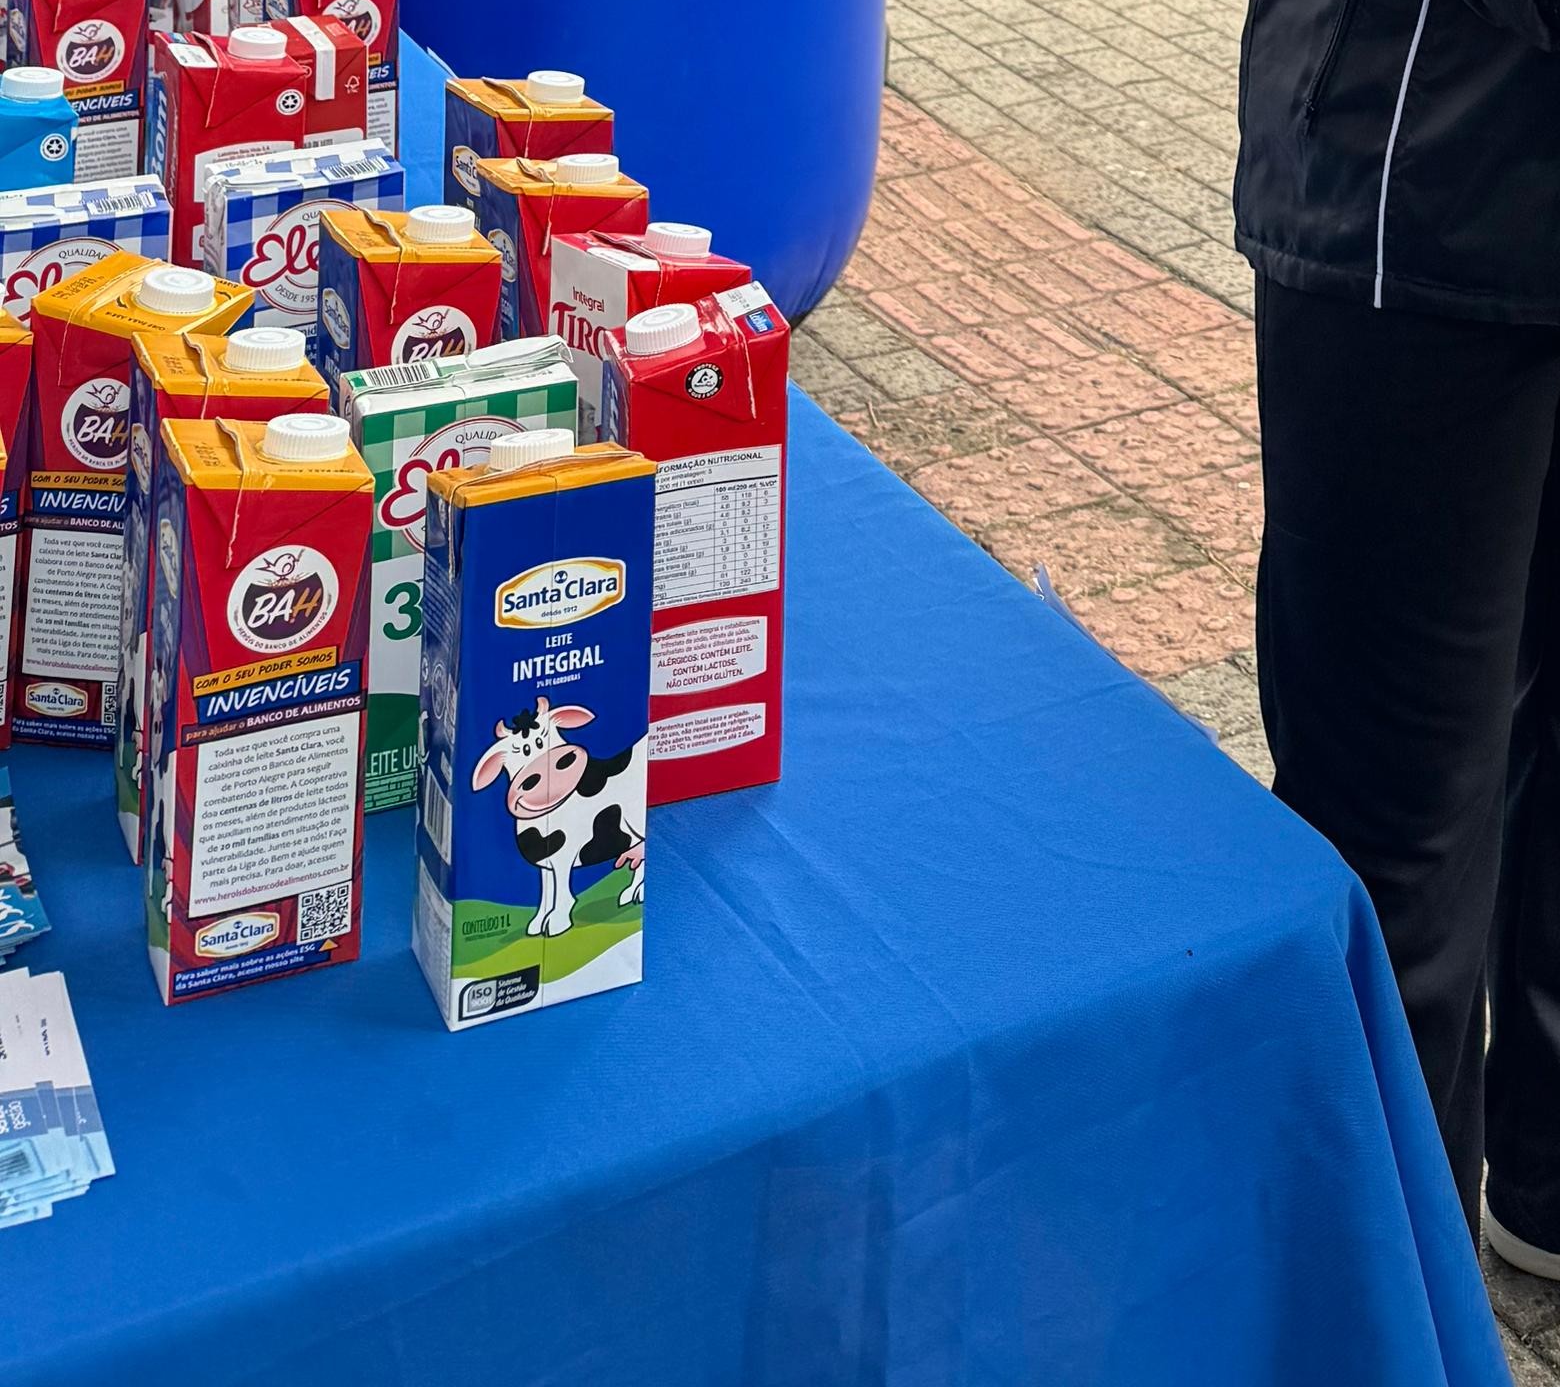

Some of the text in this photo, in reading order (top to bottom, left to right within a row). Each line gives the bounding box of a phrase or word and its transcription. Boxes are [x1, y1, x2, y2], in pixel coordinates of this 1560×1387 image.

[70, 45, 114, 69] BAH
[275, 283, 300, 304] DESDE
[572, 285, 605, 313] Integral
[77, 415, 127, 447] BAH
[707, 452, 763, 465] NUTRICIONAL
[32, 475, 50, 483] COM
[64, 476, 79, 484] SEU
[82, 476, 109, 485] PODER
[40, 491, 126, 512] INVENCÍV
[247, 587, 321, 628] BAH
[504, 577, 618, 613] Santa Clara
[564, 606, 578, 614] 1912
[546, 633, 573, 648] LEITE
[195, 652, 333, 690] COM O SEU PODER SOMOS
[512, 645, 604, 683] INTEGRAL
[657, 651, 699, 669] ALÉRGICOS:
[700, 645, 730, 662] CONTÉM
[672, 662, 704, 677] CONTÉM
[206, 668, 352, 717] INVENCÍVEIS
[666, 677, 682, 690] NÃO
[683, 671, 713, 687] CONTÉM
[29, 690, 84, 707] Santa Clara
[186, 696, 361, 742] para ajudar o BANCO DE ALIMENTOS
[208, 735, 345, 771] caixinha de leite Santa Clara, você
[214, 726, 341, 758] Toda vez que você compra uma
[203, 747, 349, 784] colabora com o Banco de Alimentos
[221, 761, 332, 792] de Porto Alegre para seguir
[201, 781, 349, 820] doa centenas de litros de leite todos
[203, 789, 258, 807] combatendo
[265, 784, 289, 795] fome.
[290, 780, 298, 789] A
[298, 770, 348, 787] Cooperativa
[198, 804, 350, 845] que auxiliam no atendimento de mais
[202, 793, 347, 831] os meses, além de produtos lácteos
[201, 921, 274, 948] Santa Clara
[462, 915, 499, 935] CONTEÚDO
[175, 973, 196, 982] Para
[197, 966, 219, 978] saber
[221, 962, 239, 972] mais
[241, 956, 264, 968] sobre
[276, 947, 298, 960] ações
[299, 944, 315, 953] ESG
[175, 955, 304, 991] da Santa Clara, acesse nosso site
[472, 987, 492, 998] ISO
